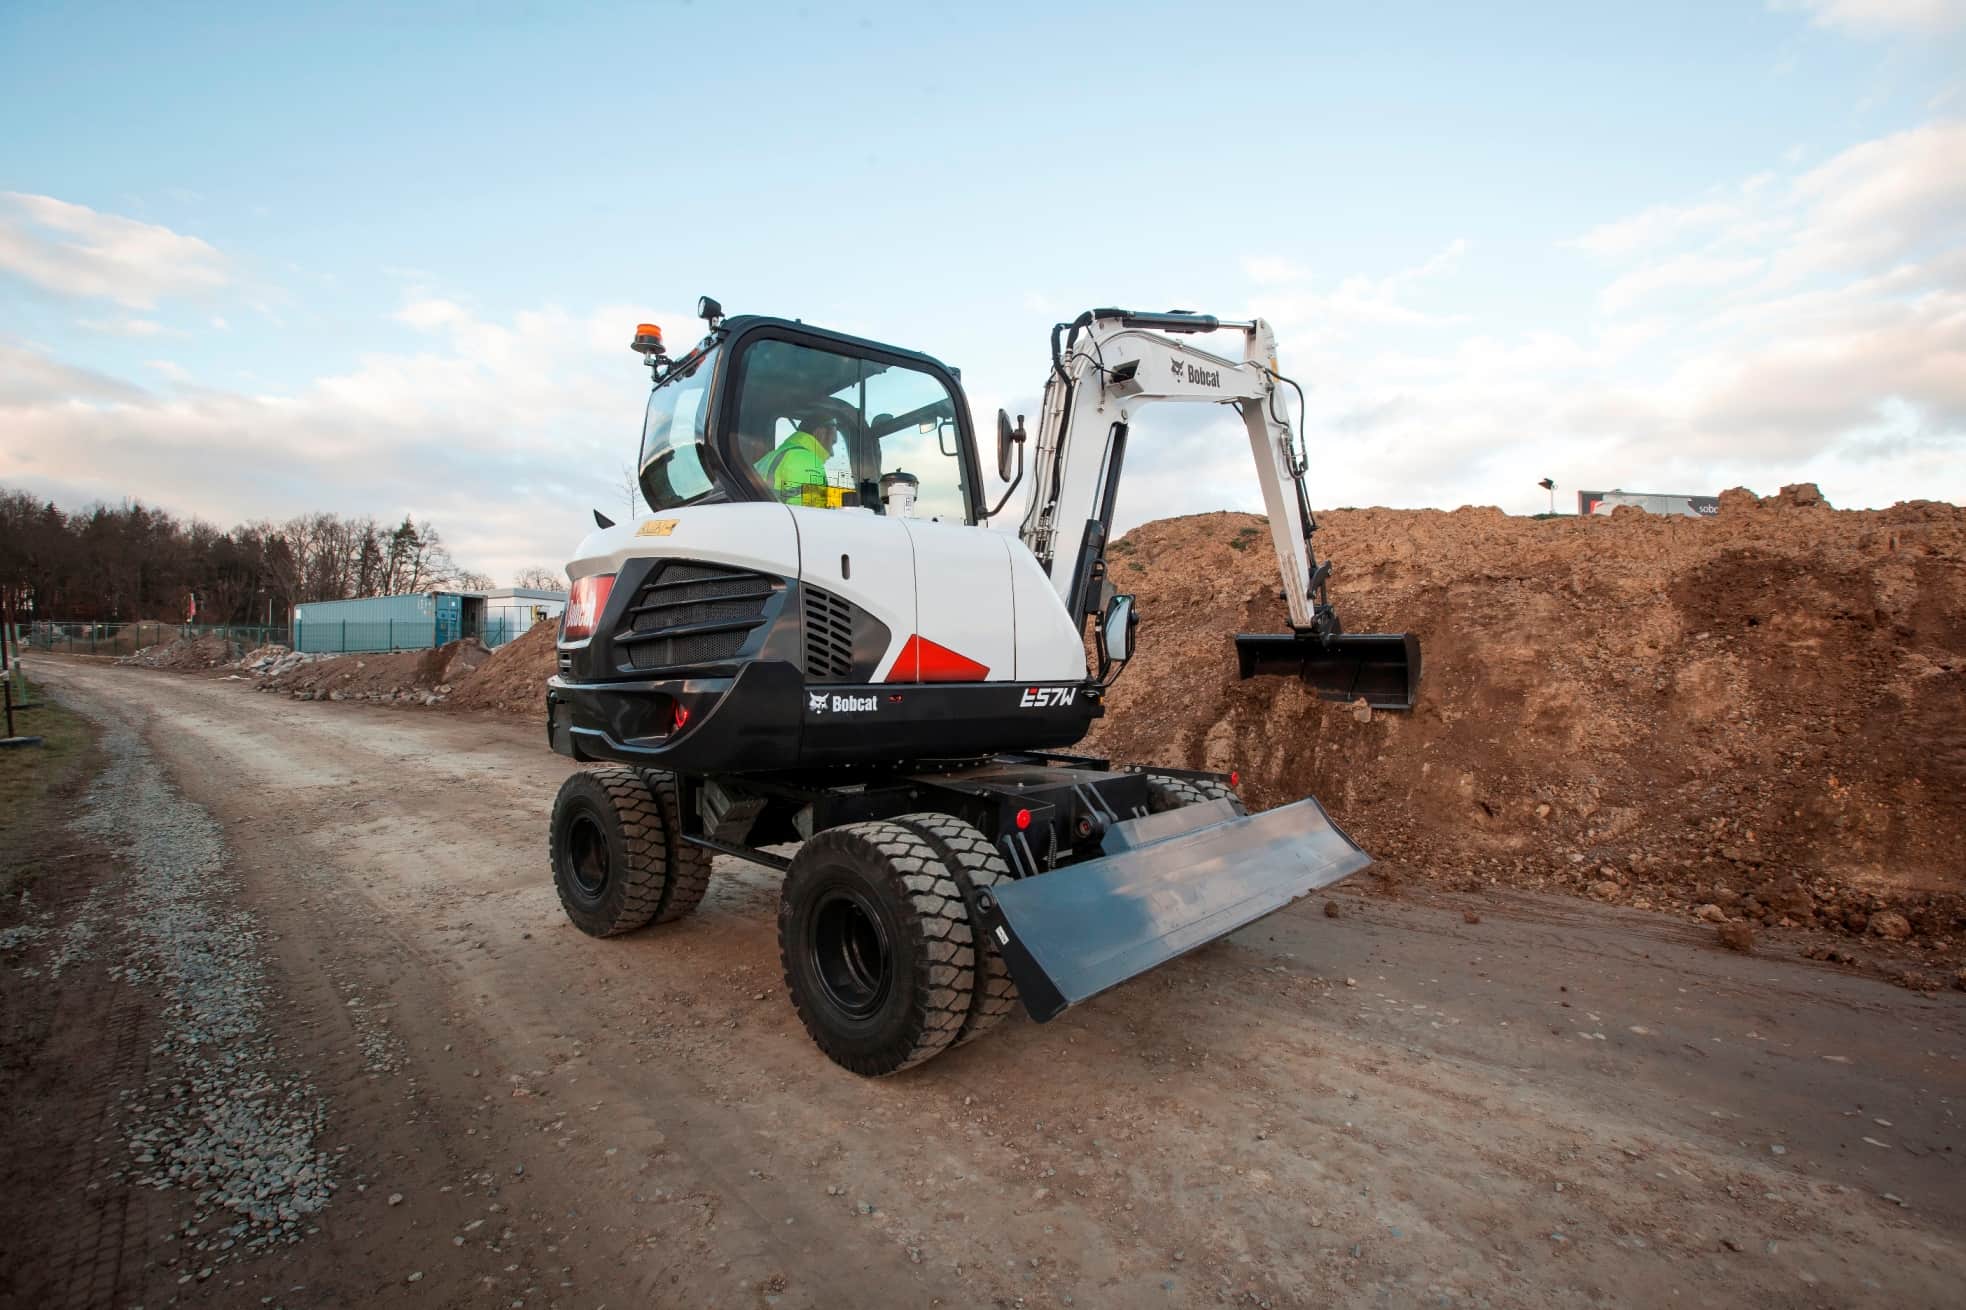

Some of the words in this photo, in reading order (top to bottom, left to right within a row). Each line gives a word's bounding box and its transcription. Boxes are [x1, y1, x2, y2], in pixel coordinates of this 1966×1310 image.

[1187, 364, 1220, 389] Bobcat
[832, 695, 878, 712] Bobcat
[1020, 687, 1077, 707] E57W
